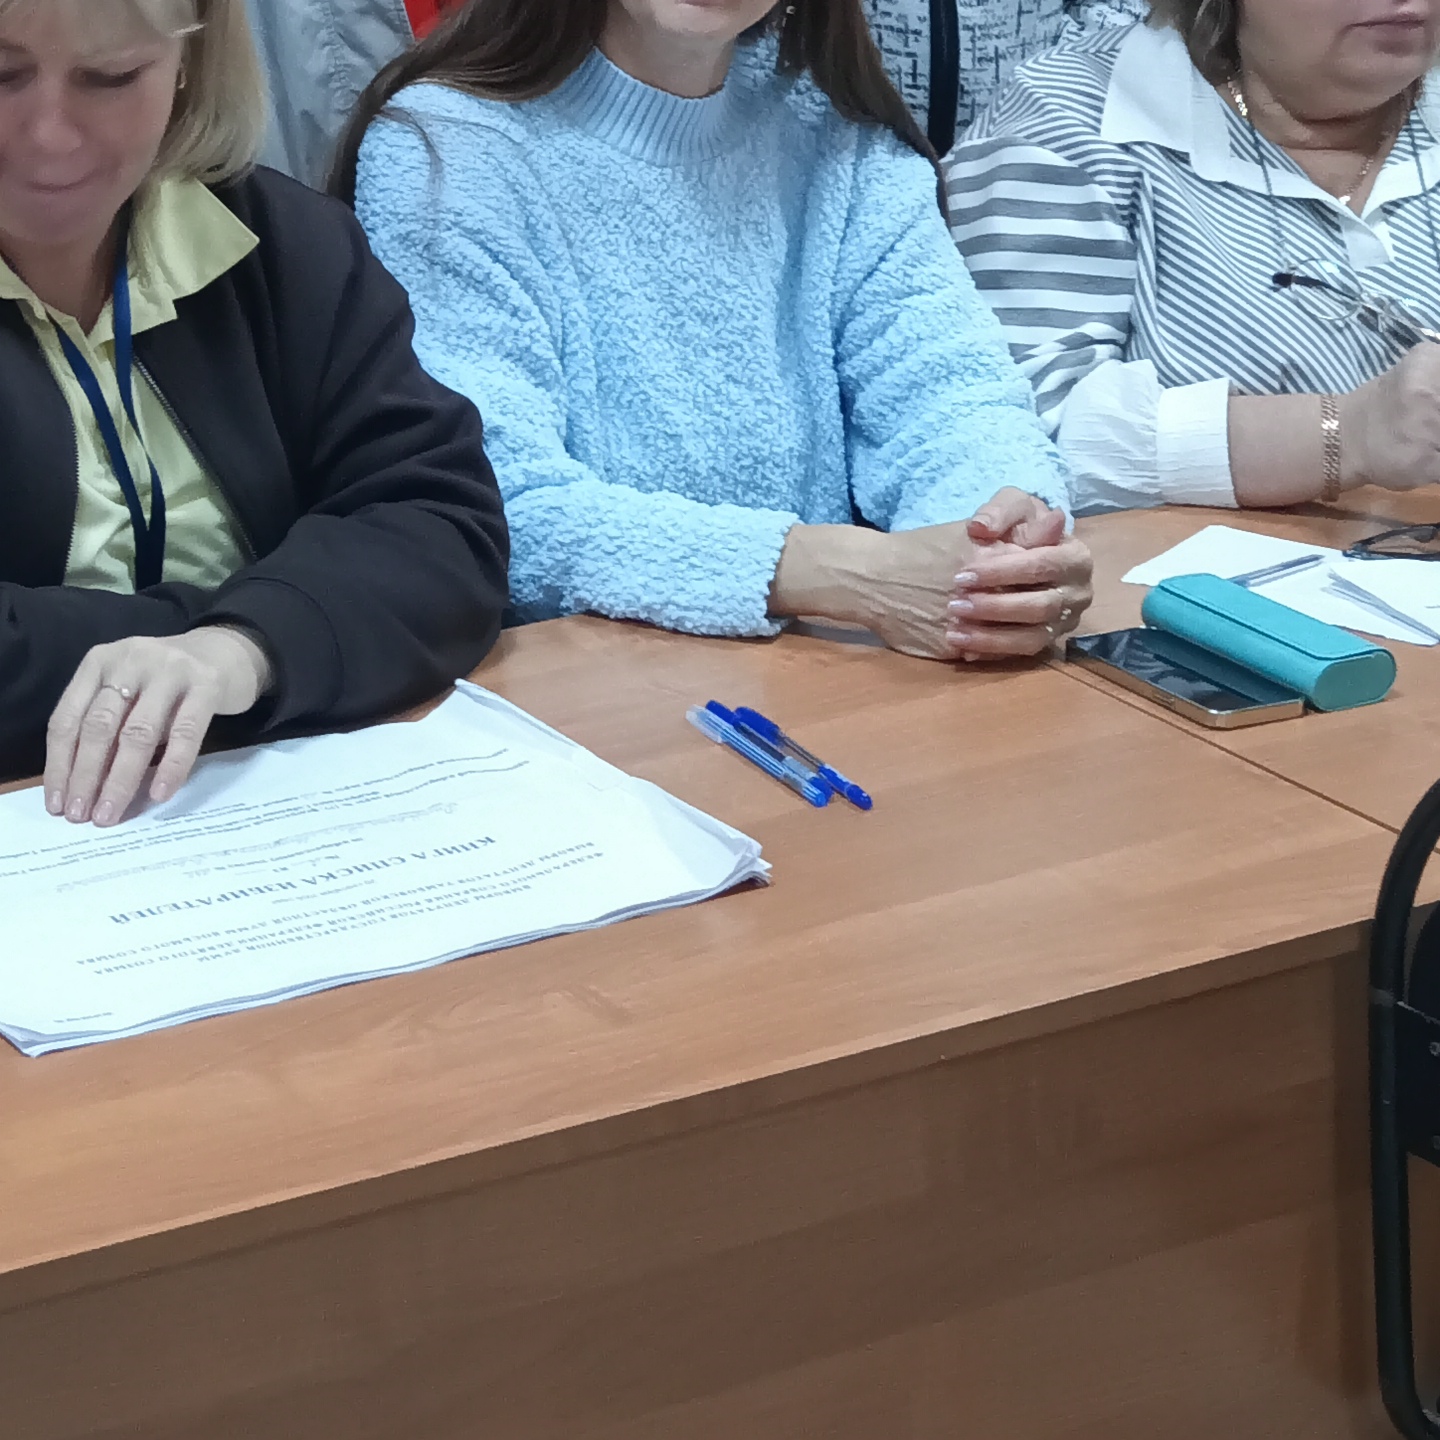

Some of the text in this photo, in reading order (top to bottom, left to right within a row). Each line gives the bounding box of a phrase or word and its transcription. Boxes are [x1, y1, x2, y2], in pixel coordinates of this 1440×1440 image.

[411, 837, 495, 859] КНИГА
[301, 857, 406, 885] СПИСКА
[109, 882, 298, 924] ИЗБИРАТЕЛЕЙ
